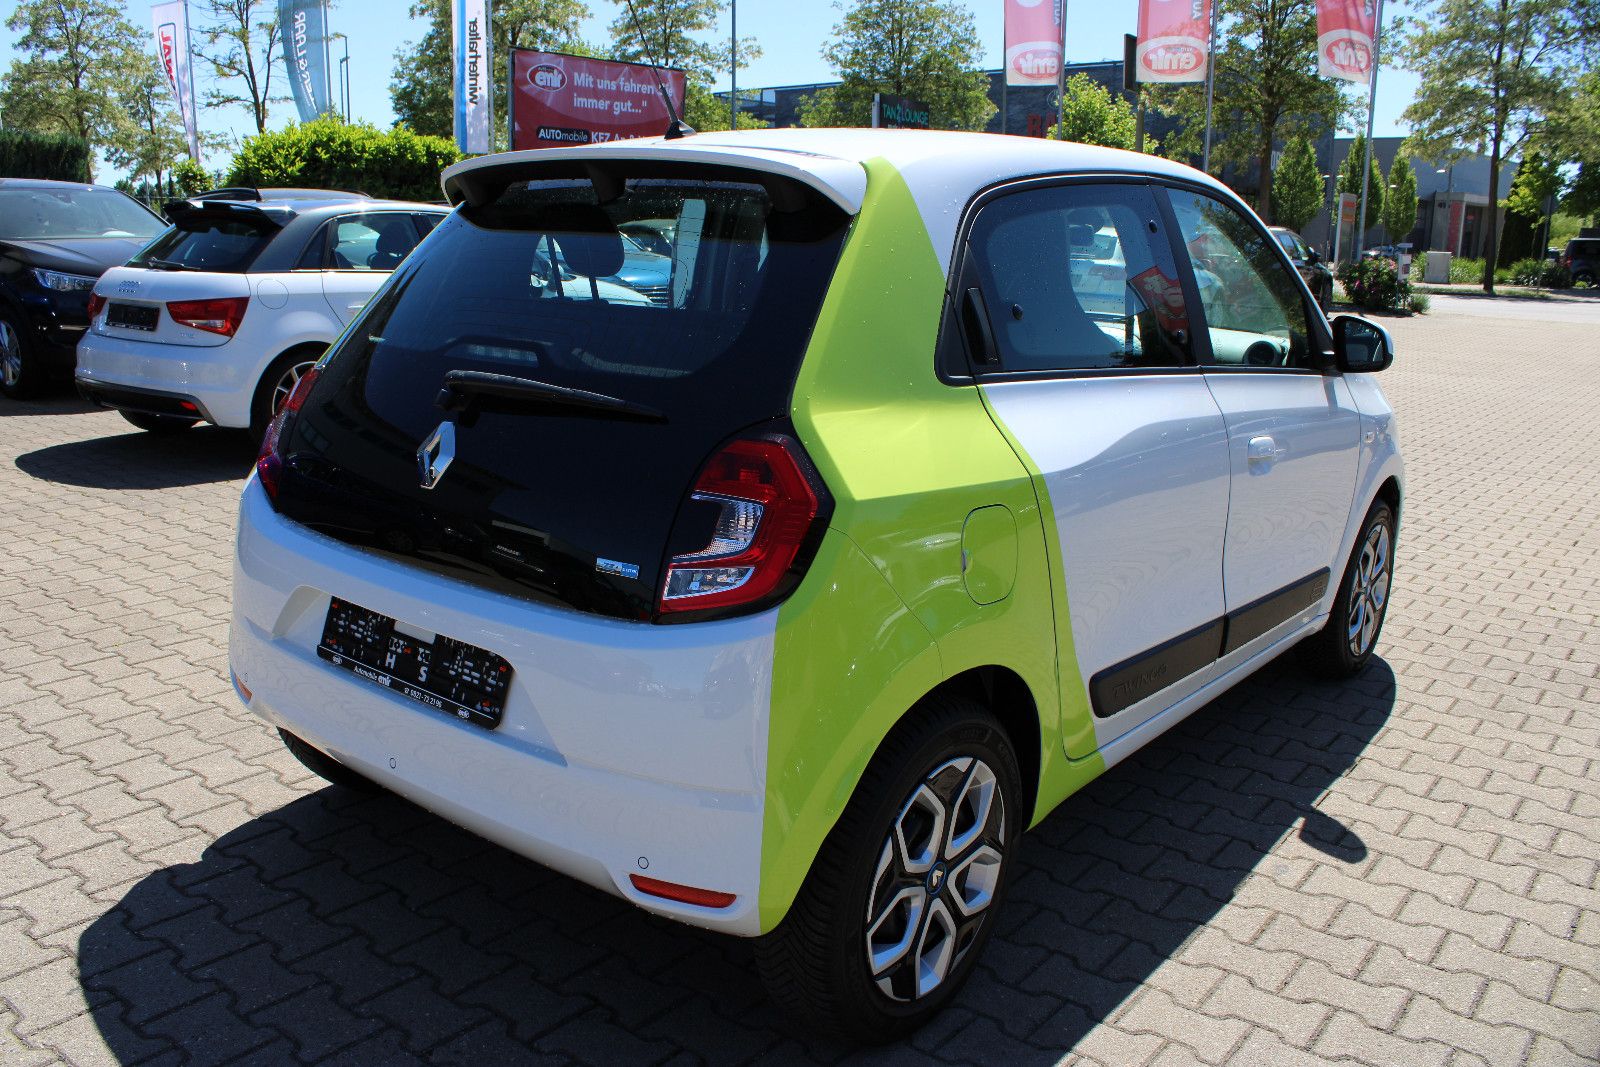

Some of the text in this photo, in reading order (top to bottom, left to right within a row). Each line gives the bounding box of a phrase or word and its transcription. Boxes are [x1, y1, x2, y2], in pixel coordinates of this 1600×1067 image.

[534, 69, 562, 88] emir
[573, 72, 594, 88] Mit
[597, 77, 617, 91] uns
[619, 77, 654, 95] fahren
[573, 93, 609, 110] immer
[538, 128, 588, 142] AUTOmobile
[591, 131, 610, 143] KFZ
